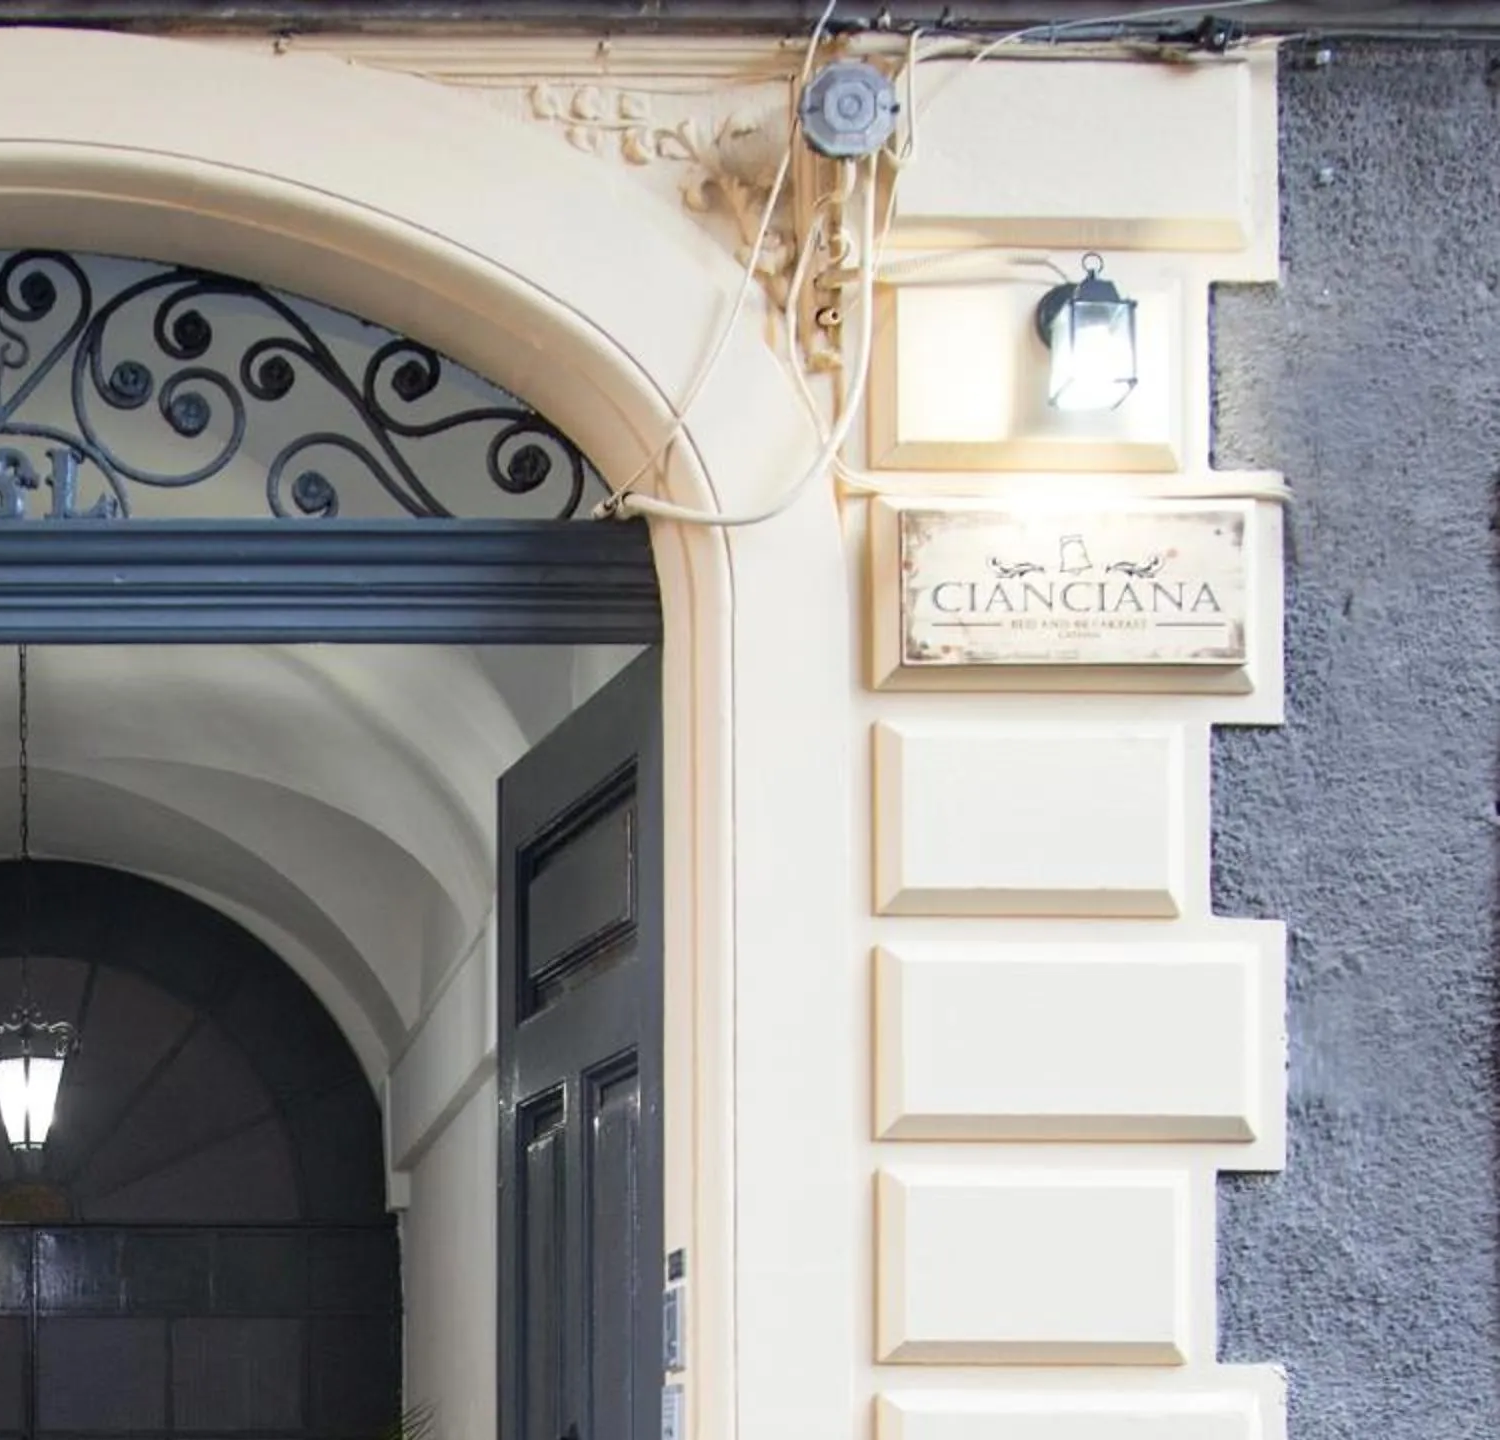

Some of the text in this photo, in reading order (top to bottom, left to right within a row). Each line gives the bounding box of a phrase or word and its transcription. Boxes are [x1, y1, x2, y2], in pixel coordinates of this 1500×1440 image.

[931, 581, 1221, 612] CIANCIANA
[1010, 618, 1038, 630] BED
[1040, 618, 1071, 630] AND
